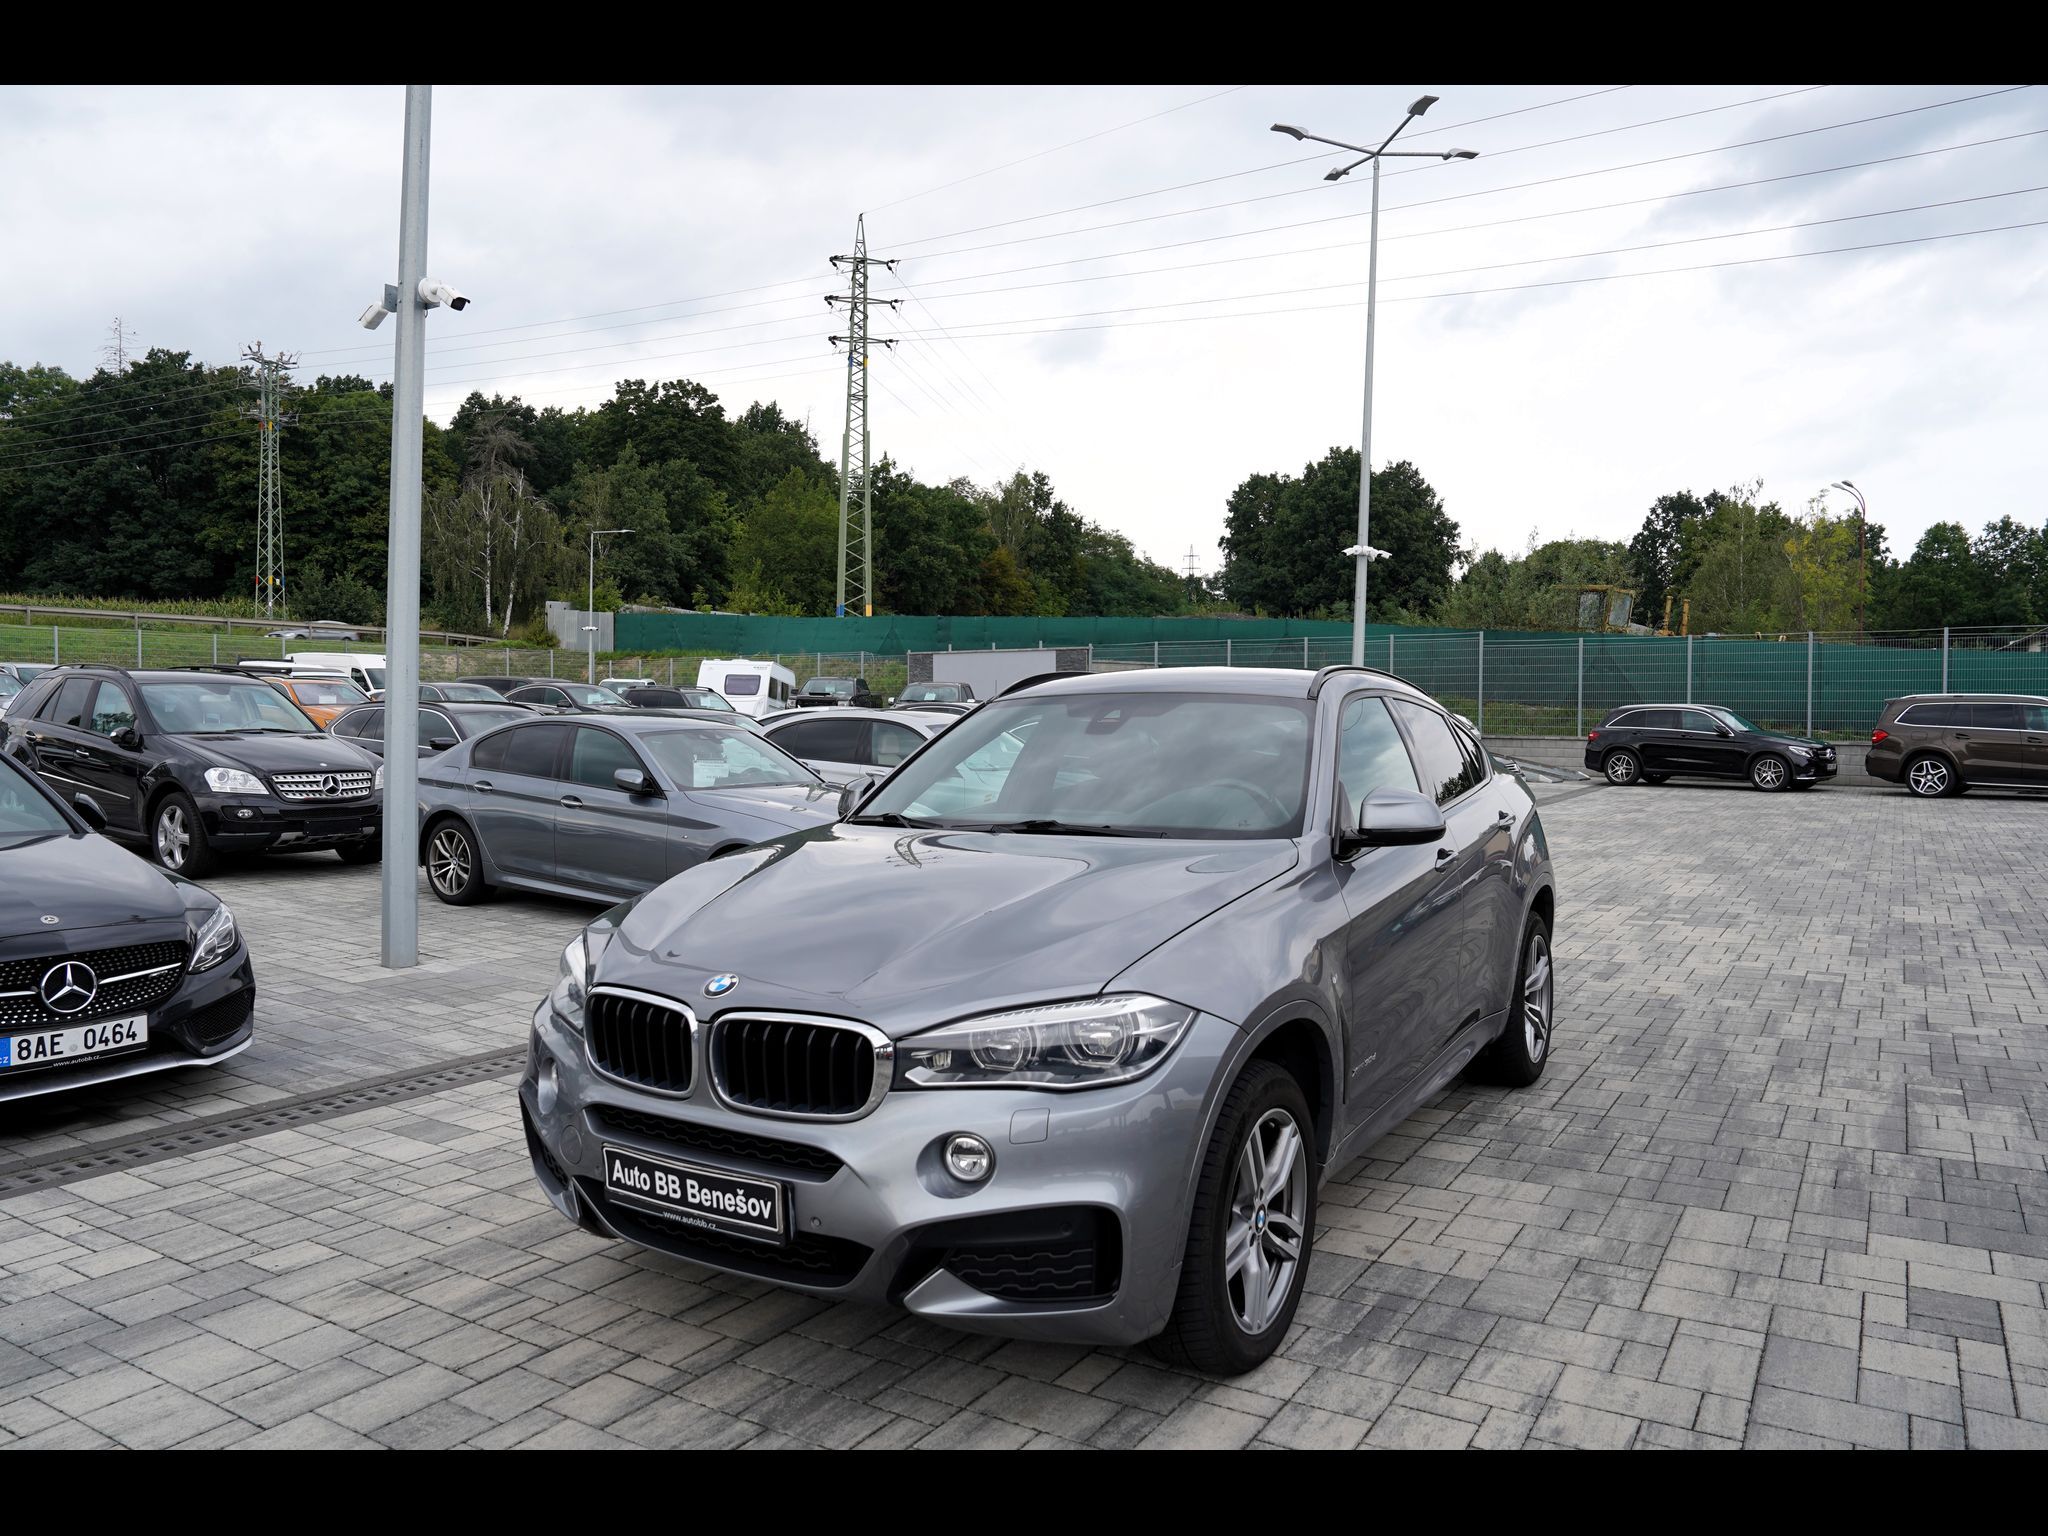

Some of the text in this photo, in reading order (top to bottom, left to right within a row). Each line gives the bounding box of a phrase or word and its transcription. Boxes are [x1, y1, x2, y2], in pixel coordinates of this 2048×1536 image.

[17, 1020, 137, 1060] 8AE 0464
[53, 1055, 100, 1067] www.autobb.cz
[612, 1159, 772, 1219] Auto BB Benešov
